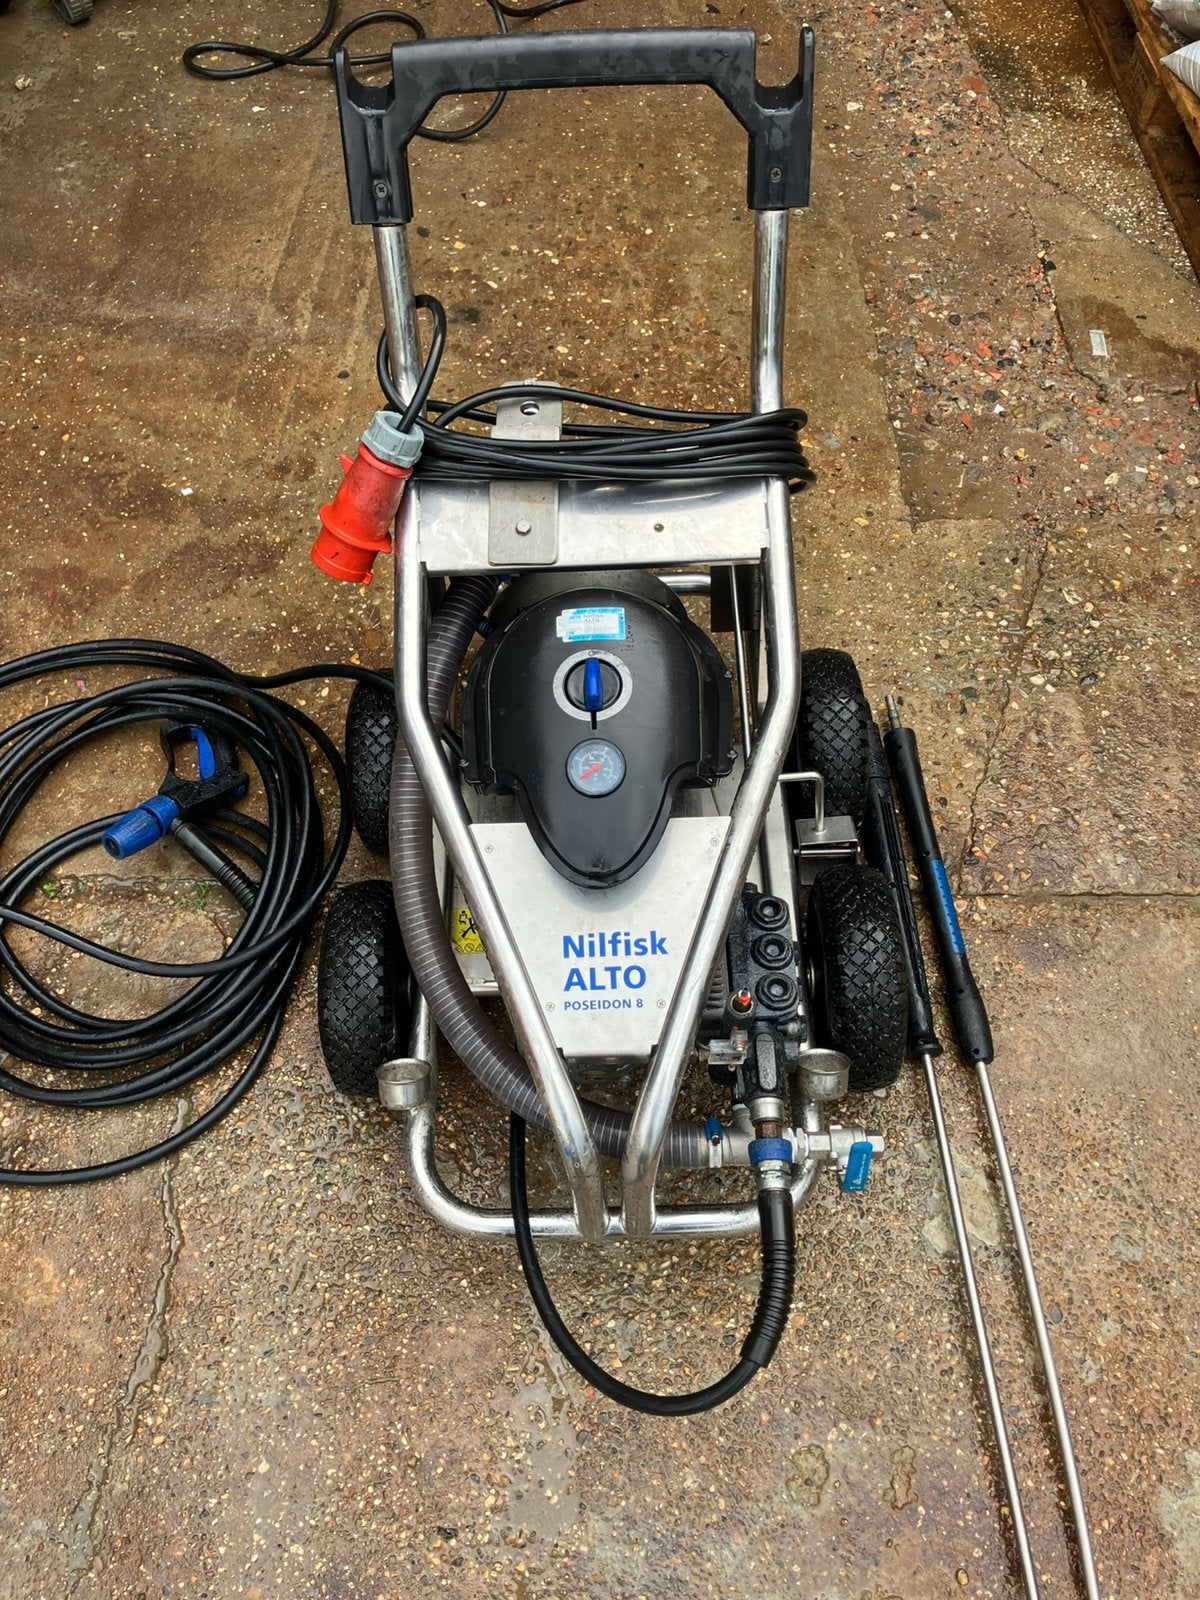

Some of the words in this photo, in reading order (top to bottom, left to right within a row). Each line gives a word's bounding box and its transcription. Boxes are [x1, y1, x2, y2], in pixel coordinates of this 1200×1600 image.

[562, 930, 668, 959] Nilfisk
[563, 965, 647, 992] ALTO
[564, 999, 631, 1011] POSEIDON
[636, 998, 644, 1008] 8
